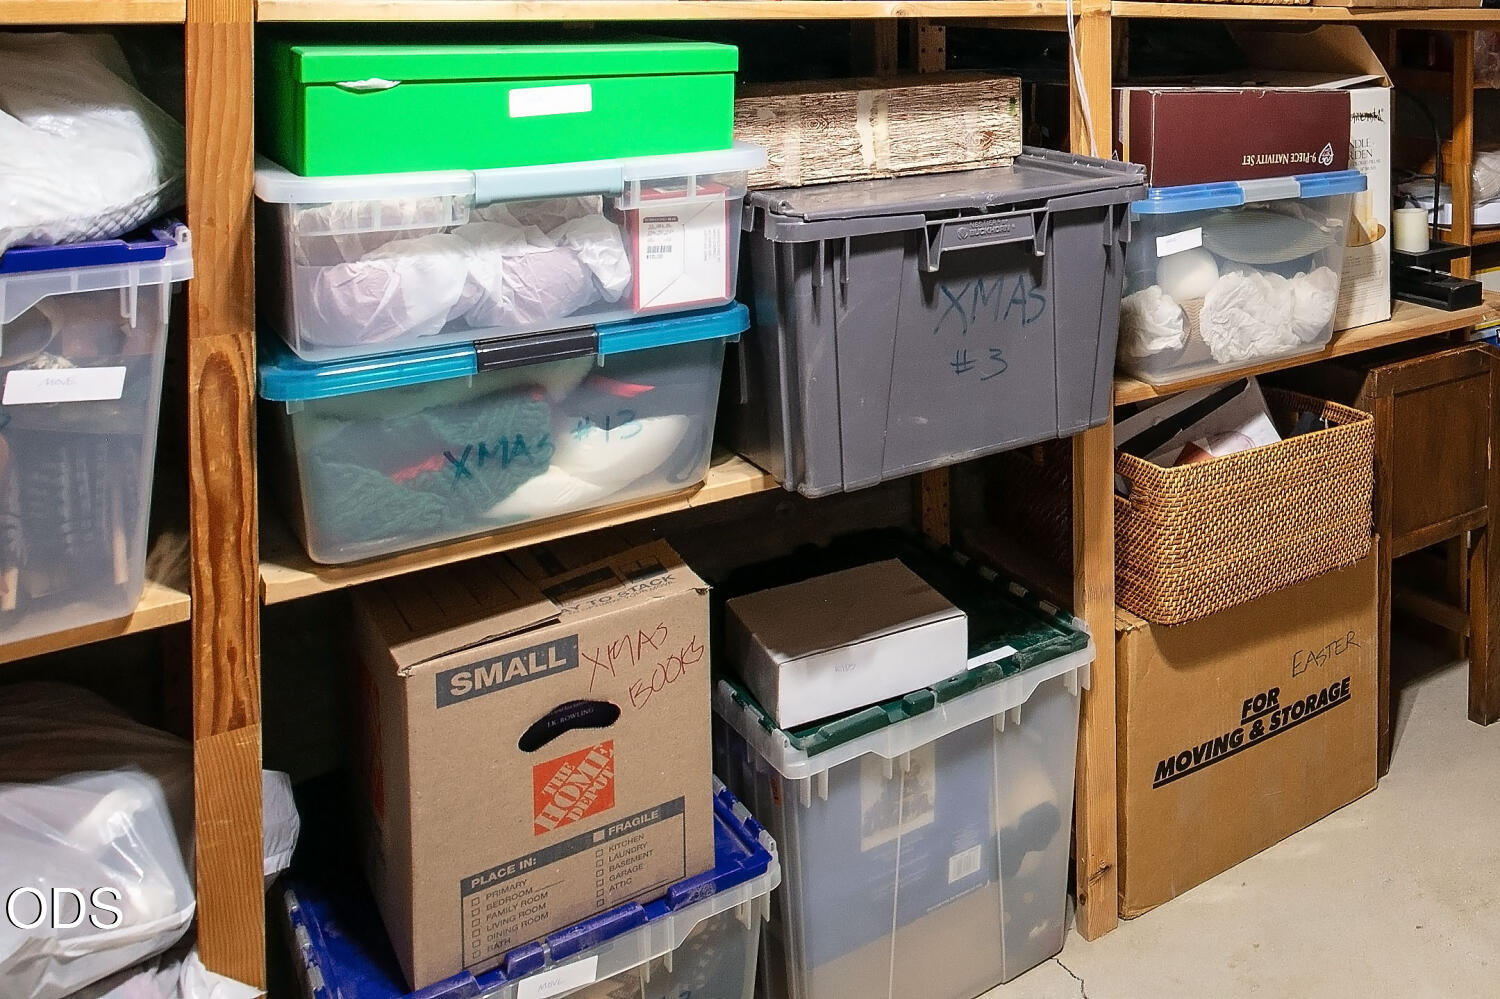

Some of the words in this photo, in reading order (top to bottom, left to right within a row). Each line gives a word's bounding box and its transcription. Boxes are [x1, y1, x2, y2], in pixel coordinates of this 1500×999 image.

[1242, 155, 1255, 166] SET
[1256, 154, 1289, 165] NATIVITY
[1290, 152, 1317, 164] 9-PIECE
[934, 273, 1047, 335] XMAS
[443, 433, 556, 492] XMAS
[590, 594, 613, 604] TO
[617, 573, 676, 599] STACK
[582, 622, 668, 693] XMAS
[1292, 630, 1361, 678] EASTER
[450, 646, 567, 696] SMALL
[628, 635, 705, 710] BOOKS
[560, 707, 594, 724] ROWLING
[1241, 686, 1280, 719] FOR
[1154, 728, 1244, 782] MOVING
[1249, 719, 1264, 741] &
[1269, 676, 1351, 731] STORAGE
[534, 743, 614, 831] HOME
[542, 761, 575, 796] THE
[566, 765, 614, 821] DEPOT
[608, 809, 660, 837] FRAGILE
[608, 833, 644, 853] KITCHEN
[608, 841, 647, 863] LAUNDRY
[471, 863, 516, 889] PLACE
[519, 857, 537, 870] IN:
[609, 849, 654, 873] BASEMENT
[609, 864, 644, 882] GARAGE
[486, 879, 528, 900] PRIMARY
[486, 887, 533, 911] BEDROOM
[609, 877, 633, 892] ATTIC
[486, 902, 521, 922] FAMILY
[521, 891, 549, 909] ROOM
[486, 914, 516, 932] LIVING
[518, 903, 547, 918] ROOM
[487, 924, 519, 943] DINING
[521, 912, 549, 928] ROOM
[487, 938, 511, 952] BATH
